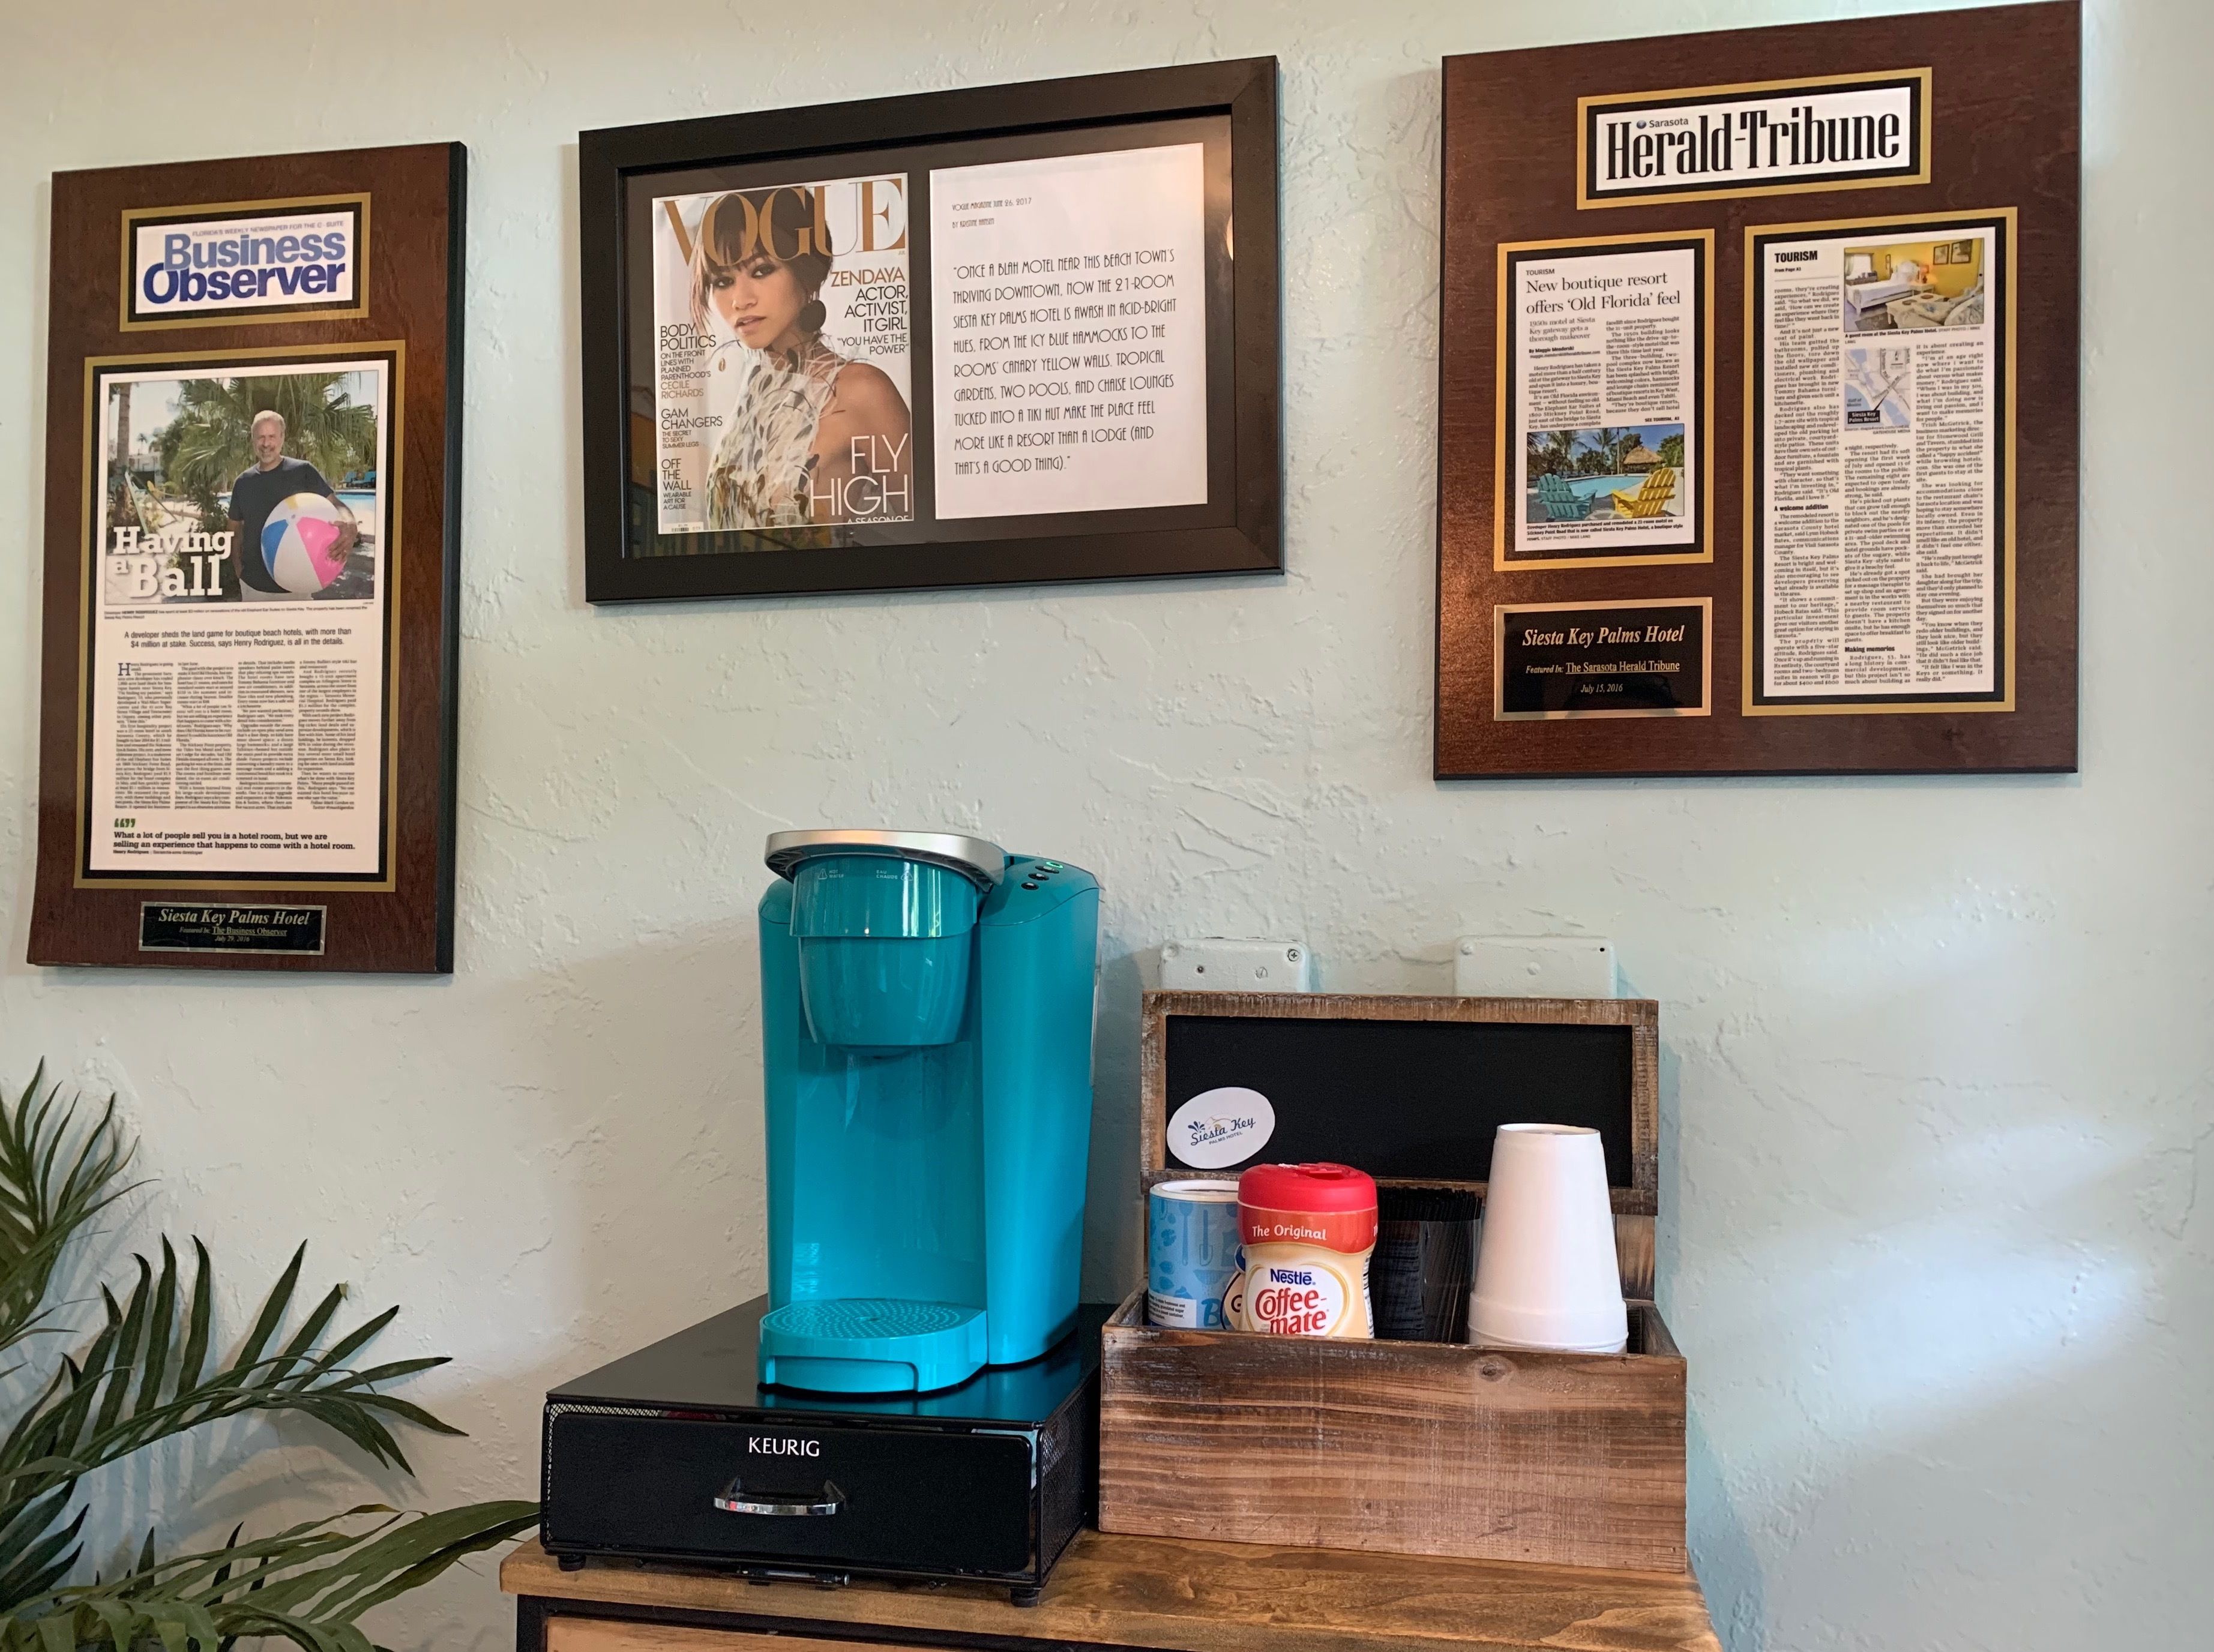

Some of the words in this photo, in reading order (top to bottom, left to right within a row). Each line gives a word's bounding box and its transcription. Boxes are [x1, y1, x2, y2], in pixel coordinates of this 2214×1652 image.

[1649, 116, 1689, 128] Sarasota
[1606, 106, 1900, 181] Herald-Tribune
[659, 178, 907, 267] VOGUE
[165, 232, 346, 270] Business
[1774, 250, 1818, 264] TOURISM
[953, 264, 985, 279] "ONCE
[988, 263, 994, 276] A
[998, 262, 1018, 276] BLAH
[1021, 259, 1054, 274] MOTEL
[1058, 257, 1080, 271] NEAR
[1083, 255, 1100, 269] THIS
[1104, 252, 1131, 268] BEACH
[1135, 248, 1175, 265] TOWN'S
[143, 262, 346, 304] Observer
[831, 266, 905, 287] ZENDAYA
[1526, 280, 1558, 293] New
[1562, 276, 1622, 291] boutique
[1628, 272, 1668, 286] resort
[855, 285, 908, 301] ACTOR,
[952, 288, 991, 304] THRIVING
[994, 283, 1062, 301] DOWNTOWN,
[1066, 280, 1094, 295] NOW
[1097, 278, 1111, 293] THE
[1115, 274, 1174, 292] 21-ROOM
[844, 301, 907, 318] ACTIVIST,
[1526, 299, 1563, 314] offers
[1568, 296, 1595, 311] 'Old
[1602, 292, 1653, 308] Florida'
[1657, 290, 1680, 305] feel
[953, 314, 977, 328] SIESTA
[981, 313, 996, 326] KEY
[1000, 310, 1027, 325] PALMS
[1030, 308, 1061, 322] HOTEL
[1064, 307, 1071, 320] IS
[1074, 305, 1103, 319] AWASH
[1107, 304, 1116, 317] IN
[1119, 298, 1176, 316] ACID-BRIGHT
[661, 323, 696, 338] BODY
[864, 319, 873, 332] IT
[875, 317, 907, 331] GIRL
[661, 335, 716, 351] POLITICS
[864, 334, 889, 345] HAVE
[890, 333, 907, 343] THE
[979, 337, 1010, 351] FROM
[1013, 334, 1027, 348] THE
[1030, 334, 1045, 347] ICY
[1049, 332, 1069, 346] BLUE
[1072, 327, 1128, 344] HAMMOCKS
[1131, 325, 1148, 340] TO
[1151, 324, 1166, 338] THE
[954, 361, 998, 377] ROOMS'
[1002, 359, 1037, 373] CANARY
[1041, 356, 1080, 371] YELLOW
[1116, 349, 1164, 366] TROPICAL
[661, 371, 711, 381] PARENTHOOD'S
[661, 380, 690, 390] CECILE
[661, 388, 704, 399] RICHARDS
[1000, 384, 1025, 398] TWO
[1075, 380, 1094, 394] AND
[1098, 377, 1126, 392] CHAISE
[1130, 374, 1174, 390] LOUNGES
[661, 408, 688, 419] GAM
[661, 416, 723, 430] CHANGERS
[851, 433, 908, 474] FLY
[661, 458, 681, 469] OFF
[954, 461, 980, 475] THAT'S
[983, 460, 988, 473] A
[992, 458, 1032, 473] GOOD
[663, 469, 681, 480] THE
[663, 480, 691, 491] WALL
[810, 474, 908, 517] HIGH
[113, 526, 234, 560] Having
[115, 559, 129, 573] a
[130, 554, 222, 598] Ball
[1522, 629, 1564, 646] Siesta
[1566, 628, 1594, 648] Key
[1596, 626, 1641, 643] Palms
[1644, 625, 1685, 642] Hotel
[1526, 665, 1554, 674] Featured
[1565, 662, 1581, 673] The
[1583, 662, 1617, 672] Sarasota
[1619, 661, 1646, 671] Herald
[1647, 661, 1680, 671] Tribune
[1580, 684, 1594, 694] July
[1596, 683, 1605, 692] 15,
[1607, 683, 1623, 692] 2016
[164, 832, 190, 840] people
[113, 841, 139, 849] selling
[214, 841, 248, 850] happens
[158, 908, 197, 922] Siesta
[200, 909, 226, 925] Key
[228, 910, 269, 924] Palms
[272, 911, 310, 925] Hotel
[1191, 1128, 1227, 1146] Siesta
[1230, 1118, 1256, 1131] Key
[1209, 1137, 1226, 1145] PALMS
[1226, 1131, 1243, 1140] HOTEL
[1252, 1225, 1269, 1237] The
[1274, 1224, 1327, 1240] Original
[1270, 1268, 1312, 1285] Nestlé
[1256, 1287, 1327, 1321] Coffee-
[1270, 1311, 1326, 1335] mate
[748, 1437, 820, 1458] KEURIG
